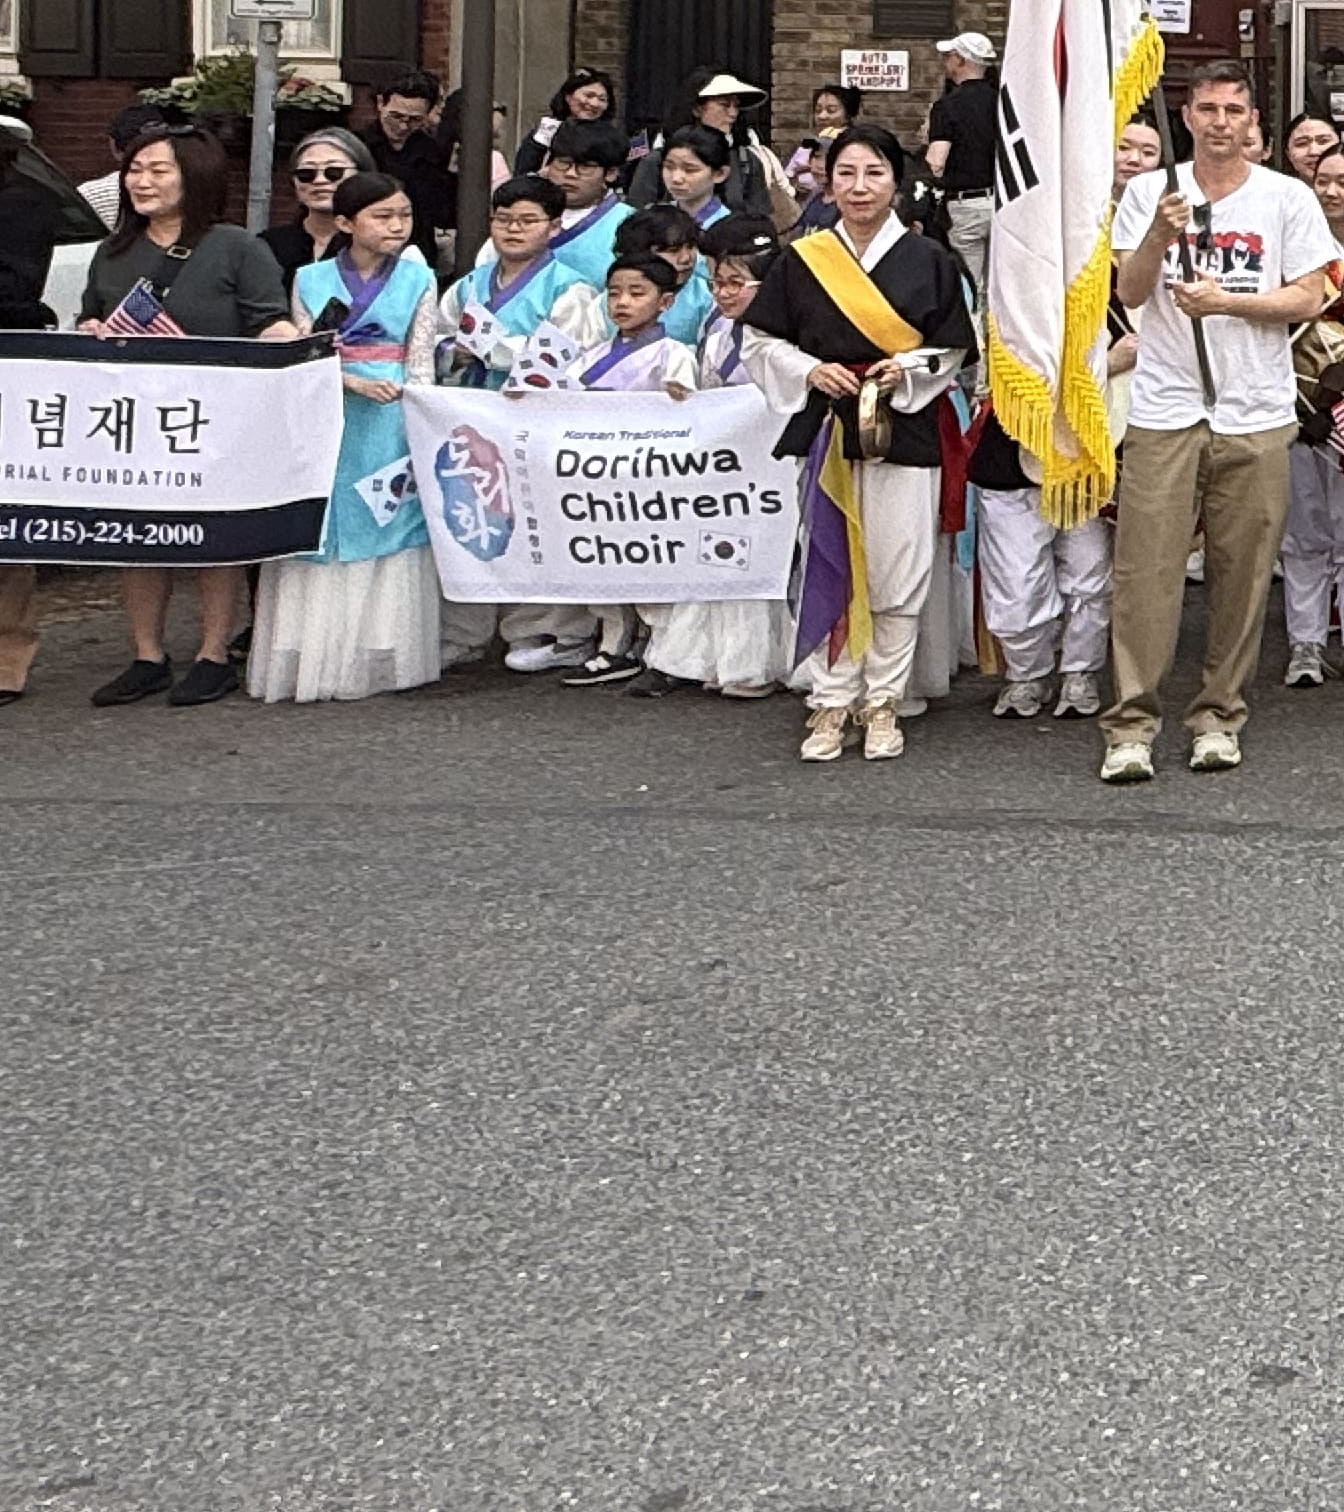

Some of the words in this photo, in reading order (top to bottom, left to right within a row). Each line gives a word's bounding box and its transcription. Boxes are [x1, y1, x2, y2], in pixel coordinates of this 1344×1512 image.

[861, 52, 888, 64] AUTO
[0, 392, 210, 454] 념재단
[0, 463, 52, 482] RIAL
[63, 466, 204, 488] FOUNDATION
[556, 447, 743, 479] Dorihwa
[561, 482, 783, 522] Children's
[24, 518, 205, 546] (215)-224-2000
[569, 534, 685, 565] Choir
